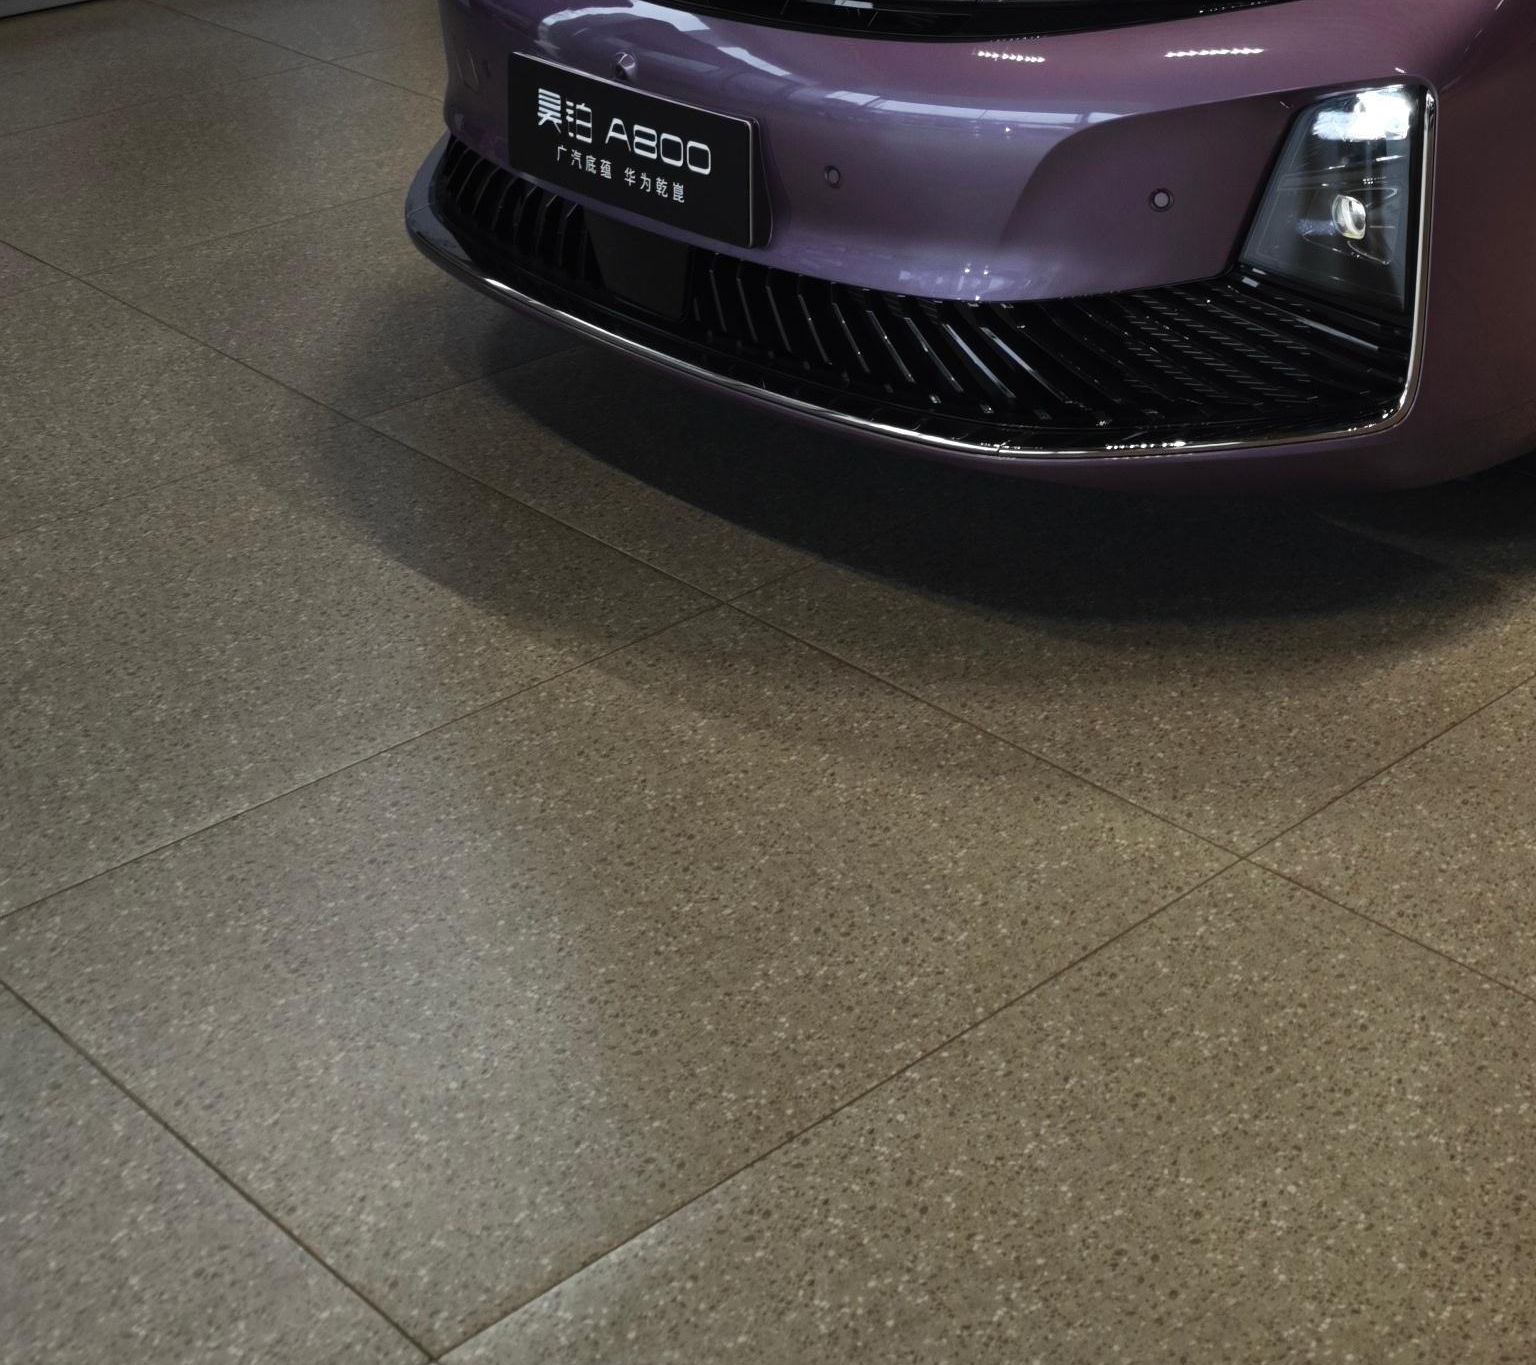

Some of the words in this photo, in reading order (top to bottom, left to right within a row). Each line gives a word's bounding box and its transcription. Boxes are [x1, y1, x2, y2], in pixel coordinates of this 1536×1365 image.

[537, 88, 592, 144] 昊铂
[605, 117, 711, 175] A800
[557, 144, 612, 180] 广汽底蕴
